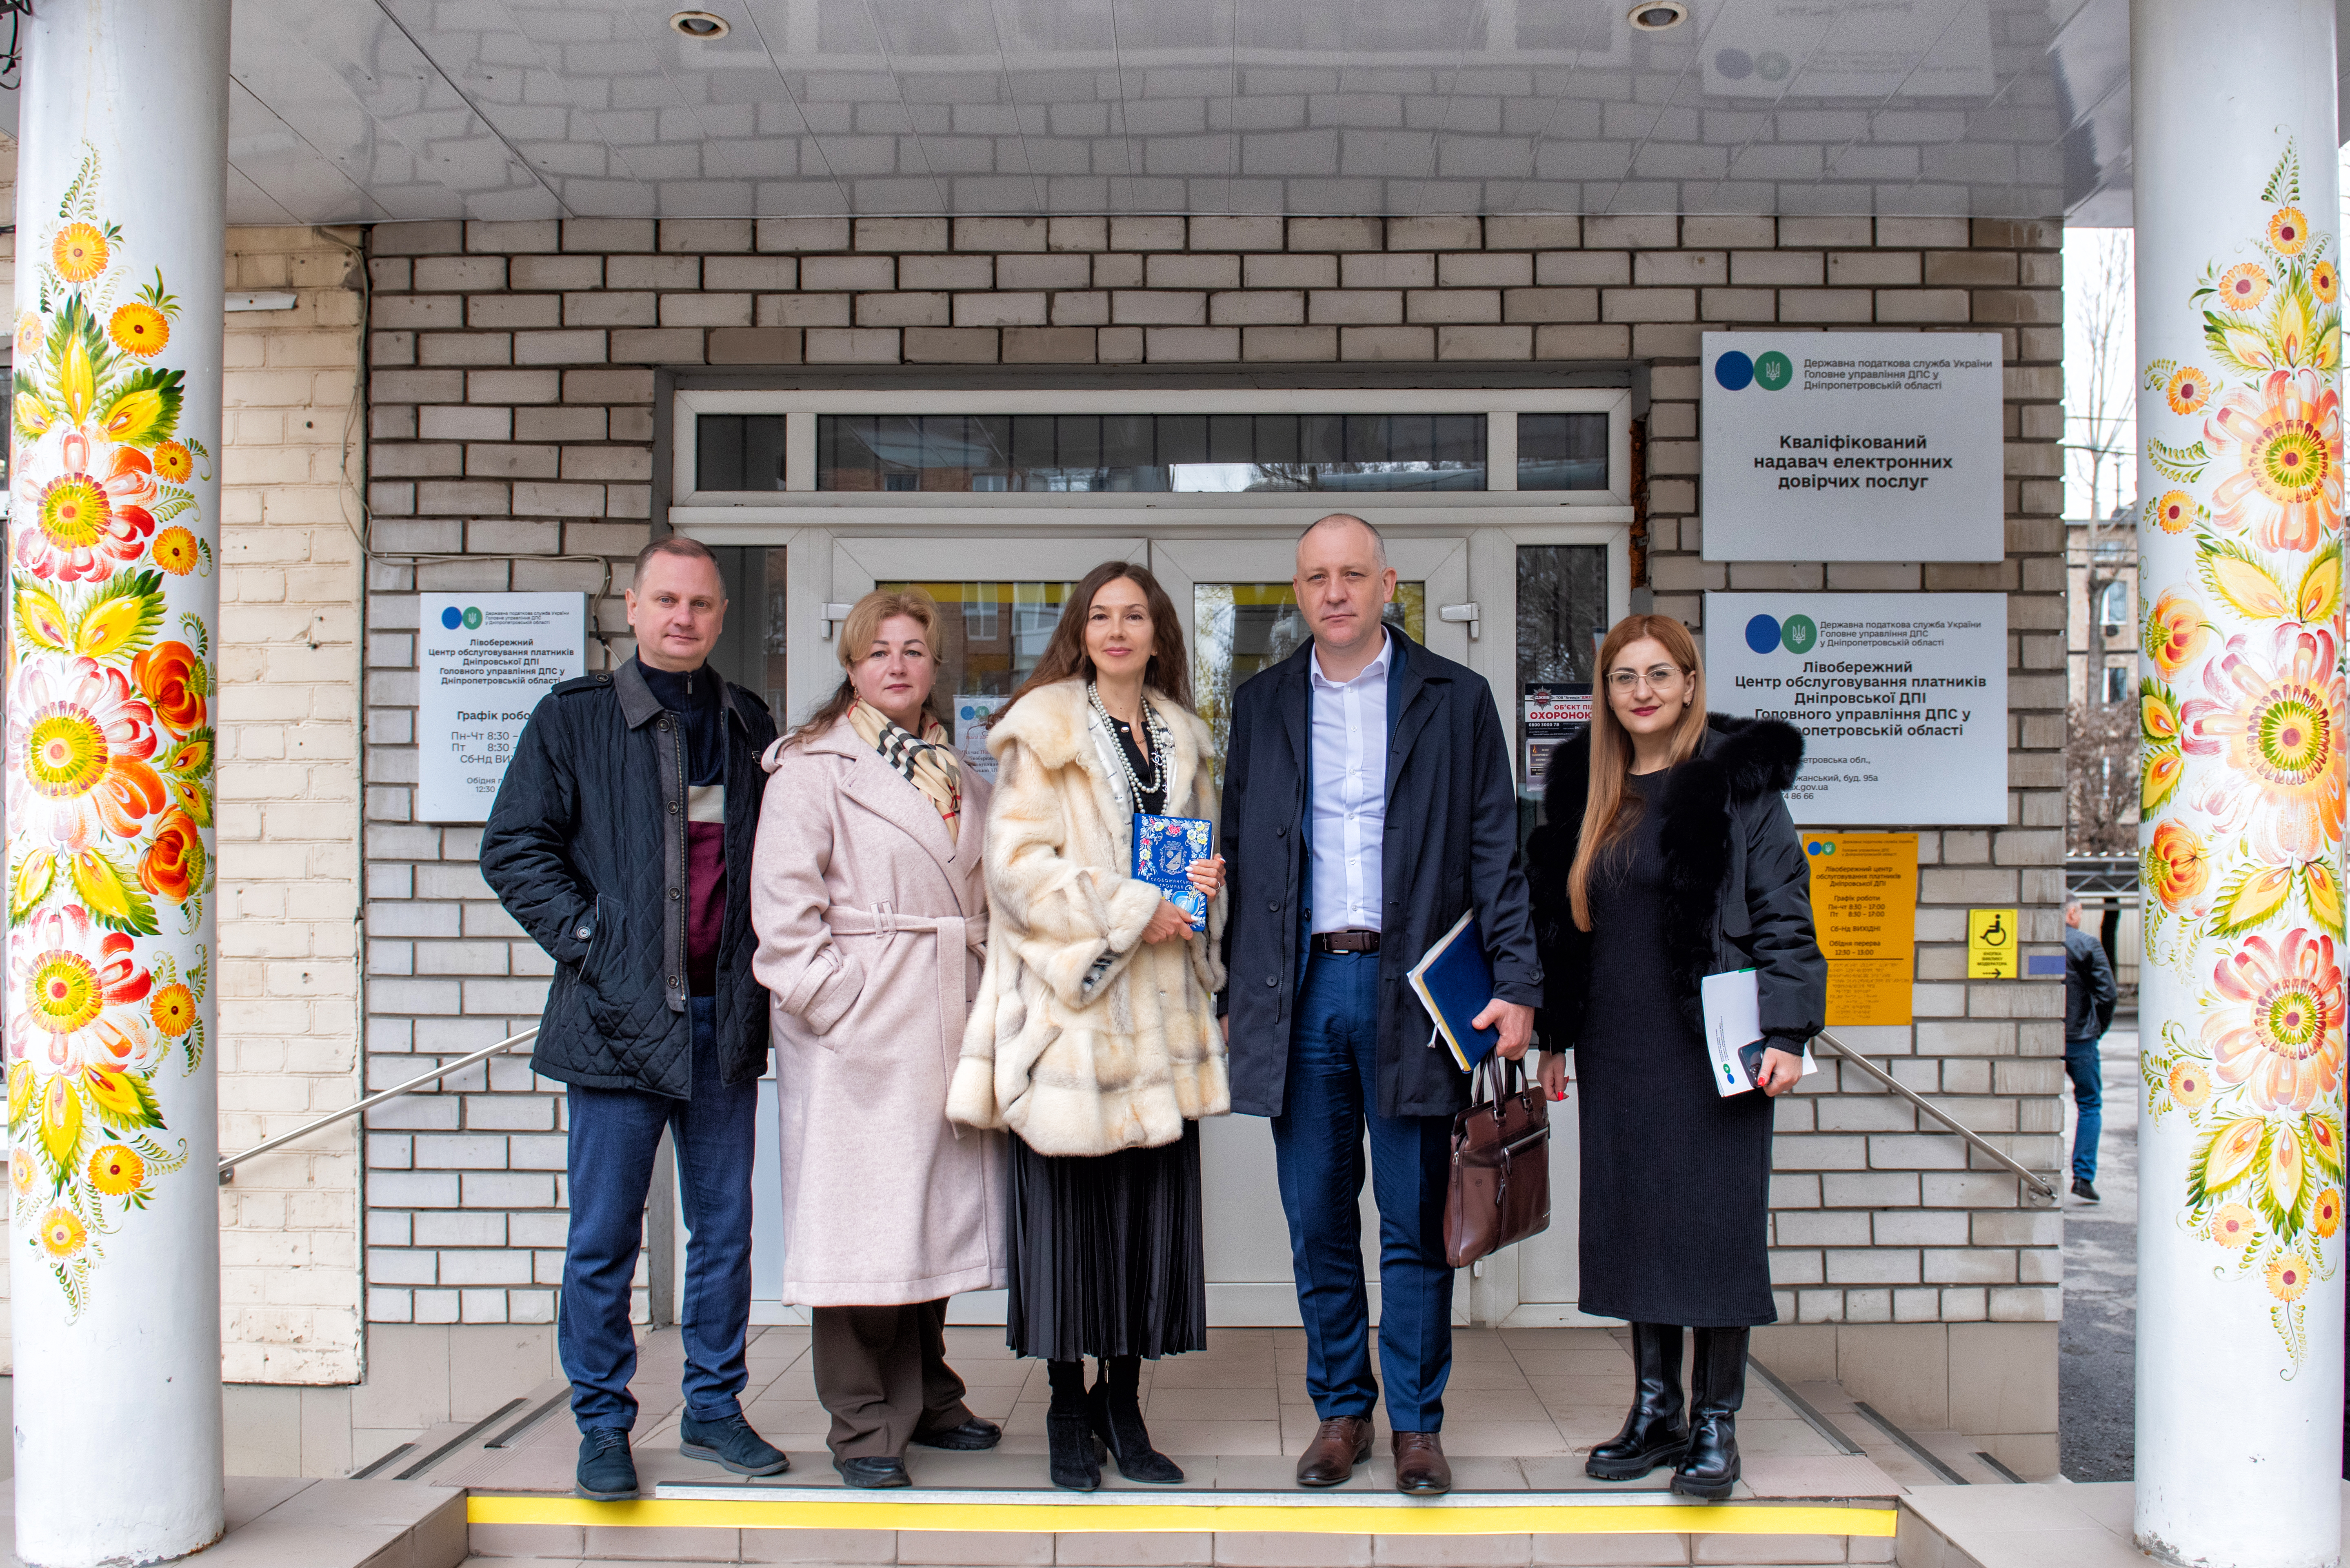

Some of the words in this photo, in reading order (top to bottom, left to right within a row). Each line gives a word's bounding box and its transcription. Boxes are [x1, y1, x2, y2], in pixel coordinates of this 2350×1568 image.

[1804, 359, 1856, 369] Державна
[1858, 360, 1911, 369] податкова
[1912, 359, 1951, 369] служба
[1953, 359, 1992, 369] України
[1804, 370, 1846, 379] Головне
[1848, 370, 1906, 381] управління
[1907, 370, 1930, 380] ДПС
[1932, 372, 1939, 381] у
[1804, 380, 1902, 391] Дніпропетровській
[1904, 381, 1942, 390] області
[1780, 435, 1927, 452] Кваліфікований
[1754, 457, 1828, 470] надавач
[1833, 457, 1952, 472] електронних
[1778, 474, 1860, 491] довірчих
[1866, 477, 1929, 492] послуг
[1820, 621, 1864, 630] Державна
[1912, 621, 1946, 630] служба
[1947, 621, 1981, 630] України
[1859, 630, 1908, 639] управління
[1909, 630, 1928, 638] ДПС
[470, 639, 533, 647] Лівобережний
[1827, 639, 1910, 648] Дніпропетровській
[458, 648, 528, 657] обслуговування
[462, 658, 522, 667] Дніпровської
[523, 658, 539, 667] ДПІ
[486, 667, 536, 676] управління
[538, 668, 558, 676] ДПС
[1803, 661, 1912, 675] Лівобережний
[441, 677, 525, 685] Дніпропетровській
[1735, 676, 1781, 690] Центр
[1786, 675, 1907, 690] обслуговування
[1912, 675, 1986, 687] платників
[1794, 692, 1896, 706] Дніпровської
[1899, 692, 1926, 706] ДПІ
[457, 710, 498, 722] Графік
[502, 710, 531, 722] робо
[1755, 708, 1831, 720] Головного
[1836, 708, 1921, 722] управління
[1925, 708, 1957, 722] ДПС
[1962, 710, 1971, 722] у
[1907, 724, 1963, 736] області
[451, 731, 484, 740] Пн-Чт
[487, 731, 510, 741] 8:30
[452, 743, 466, 752] Пт
[487, 743, 510, 752] 8:30
[460, 754, 493, 765] Сб-Нд
[1849, 756, 1871, 764] обл.,
[1796, 773, 1841, 782] жанський,
[1843, 774, 1861, 783] буд.
